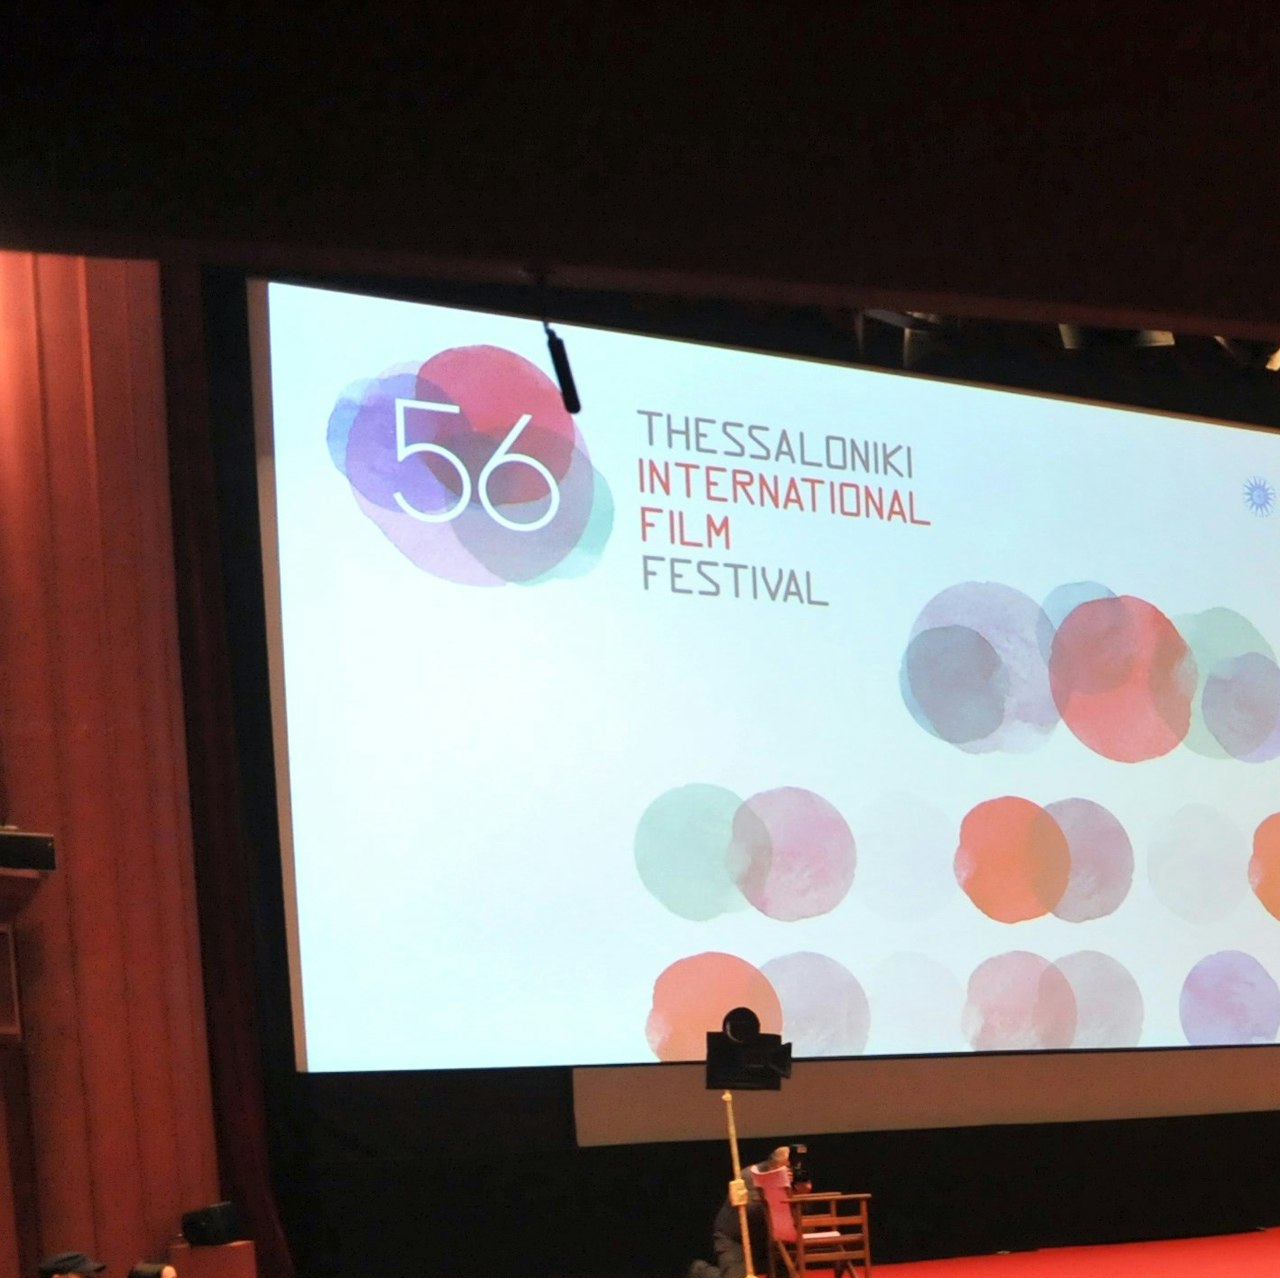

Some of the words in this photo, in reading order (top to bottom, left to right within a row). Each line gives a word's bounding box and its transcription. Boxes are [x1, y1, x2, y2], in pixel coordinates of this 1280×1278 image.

[393, 398, 561, 532] 56
[637, 409, 914, 479] THESSALONIKI
[638, 458, 932, 526] INTERNATIONAL
[639, 506, 732, 550] FILM
[642, 555, 829, 606] FESTIVAL
